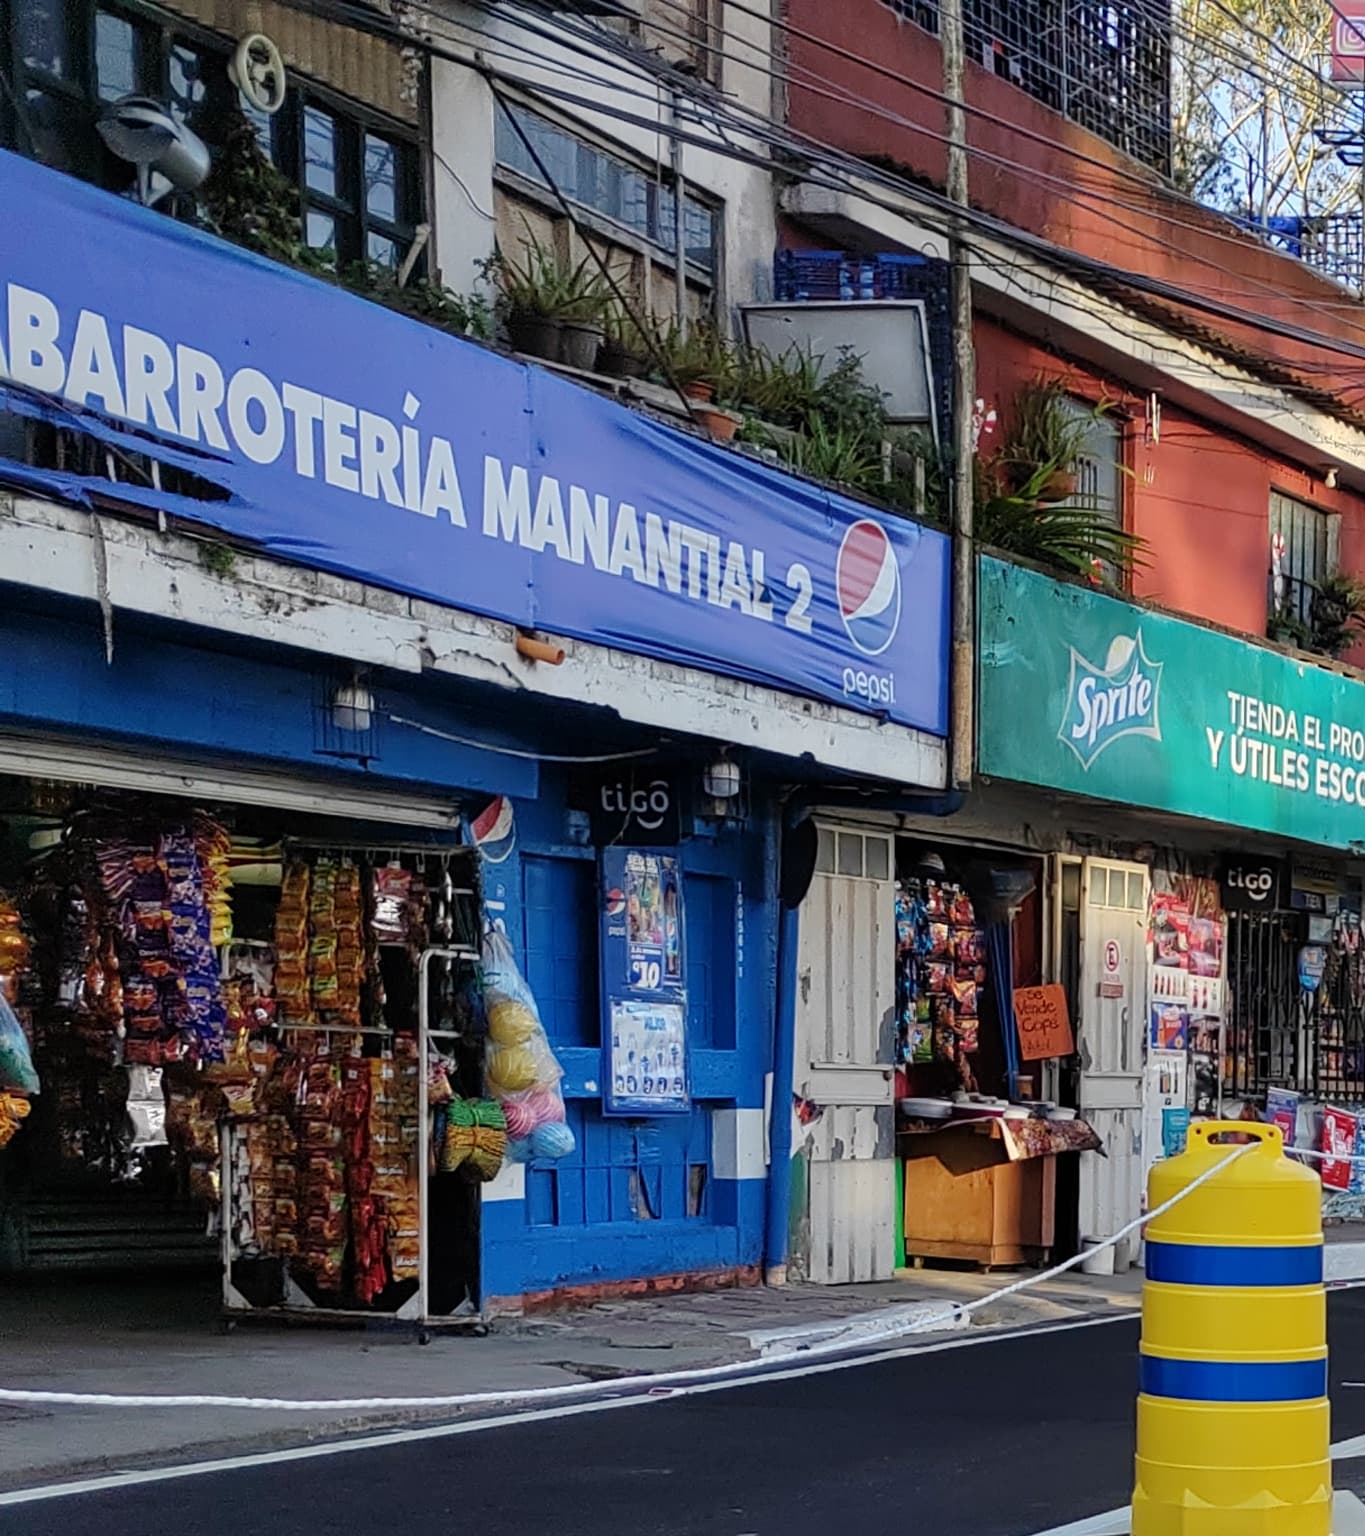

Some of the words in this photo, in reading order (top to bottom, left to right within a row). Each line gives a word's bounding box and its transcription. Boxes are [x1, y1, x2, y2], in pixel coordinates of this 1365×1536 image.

[0, 283, 467, 528] BARROTERÍA
[482, 455, 775, 620] MANANTIAL
[785, 562, 814, 633] 2
[842, 664, 896, 704] pepsi
[1071, 657, 1153, 748] Sprite
[1228, 691, 1299, 745] TIENDA
[1303, 714, 1326, 751] EL
[1206, 728, 1223, 767] Y
[1229, 727, 1311, 796] ÚTILES
